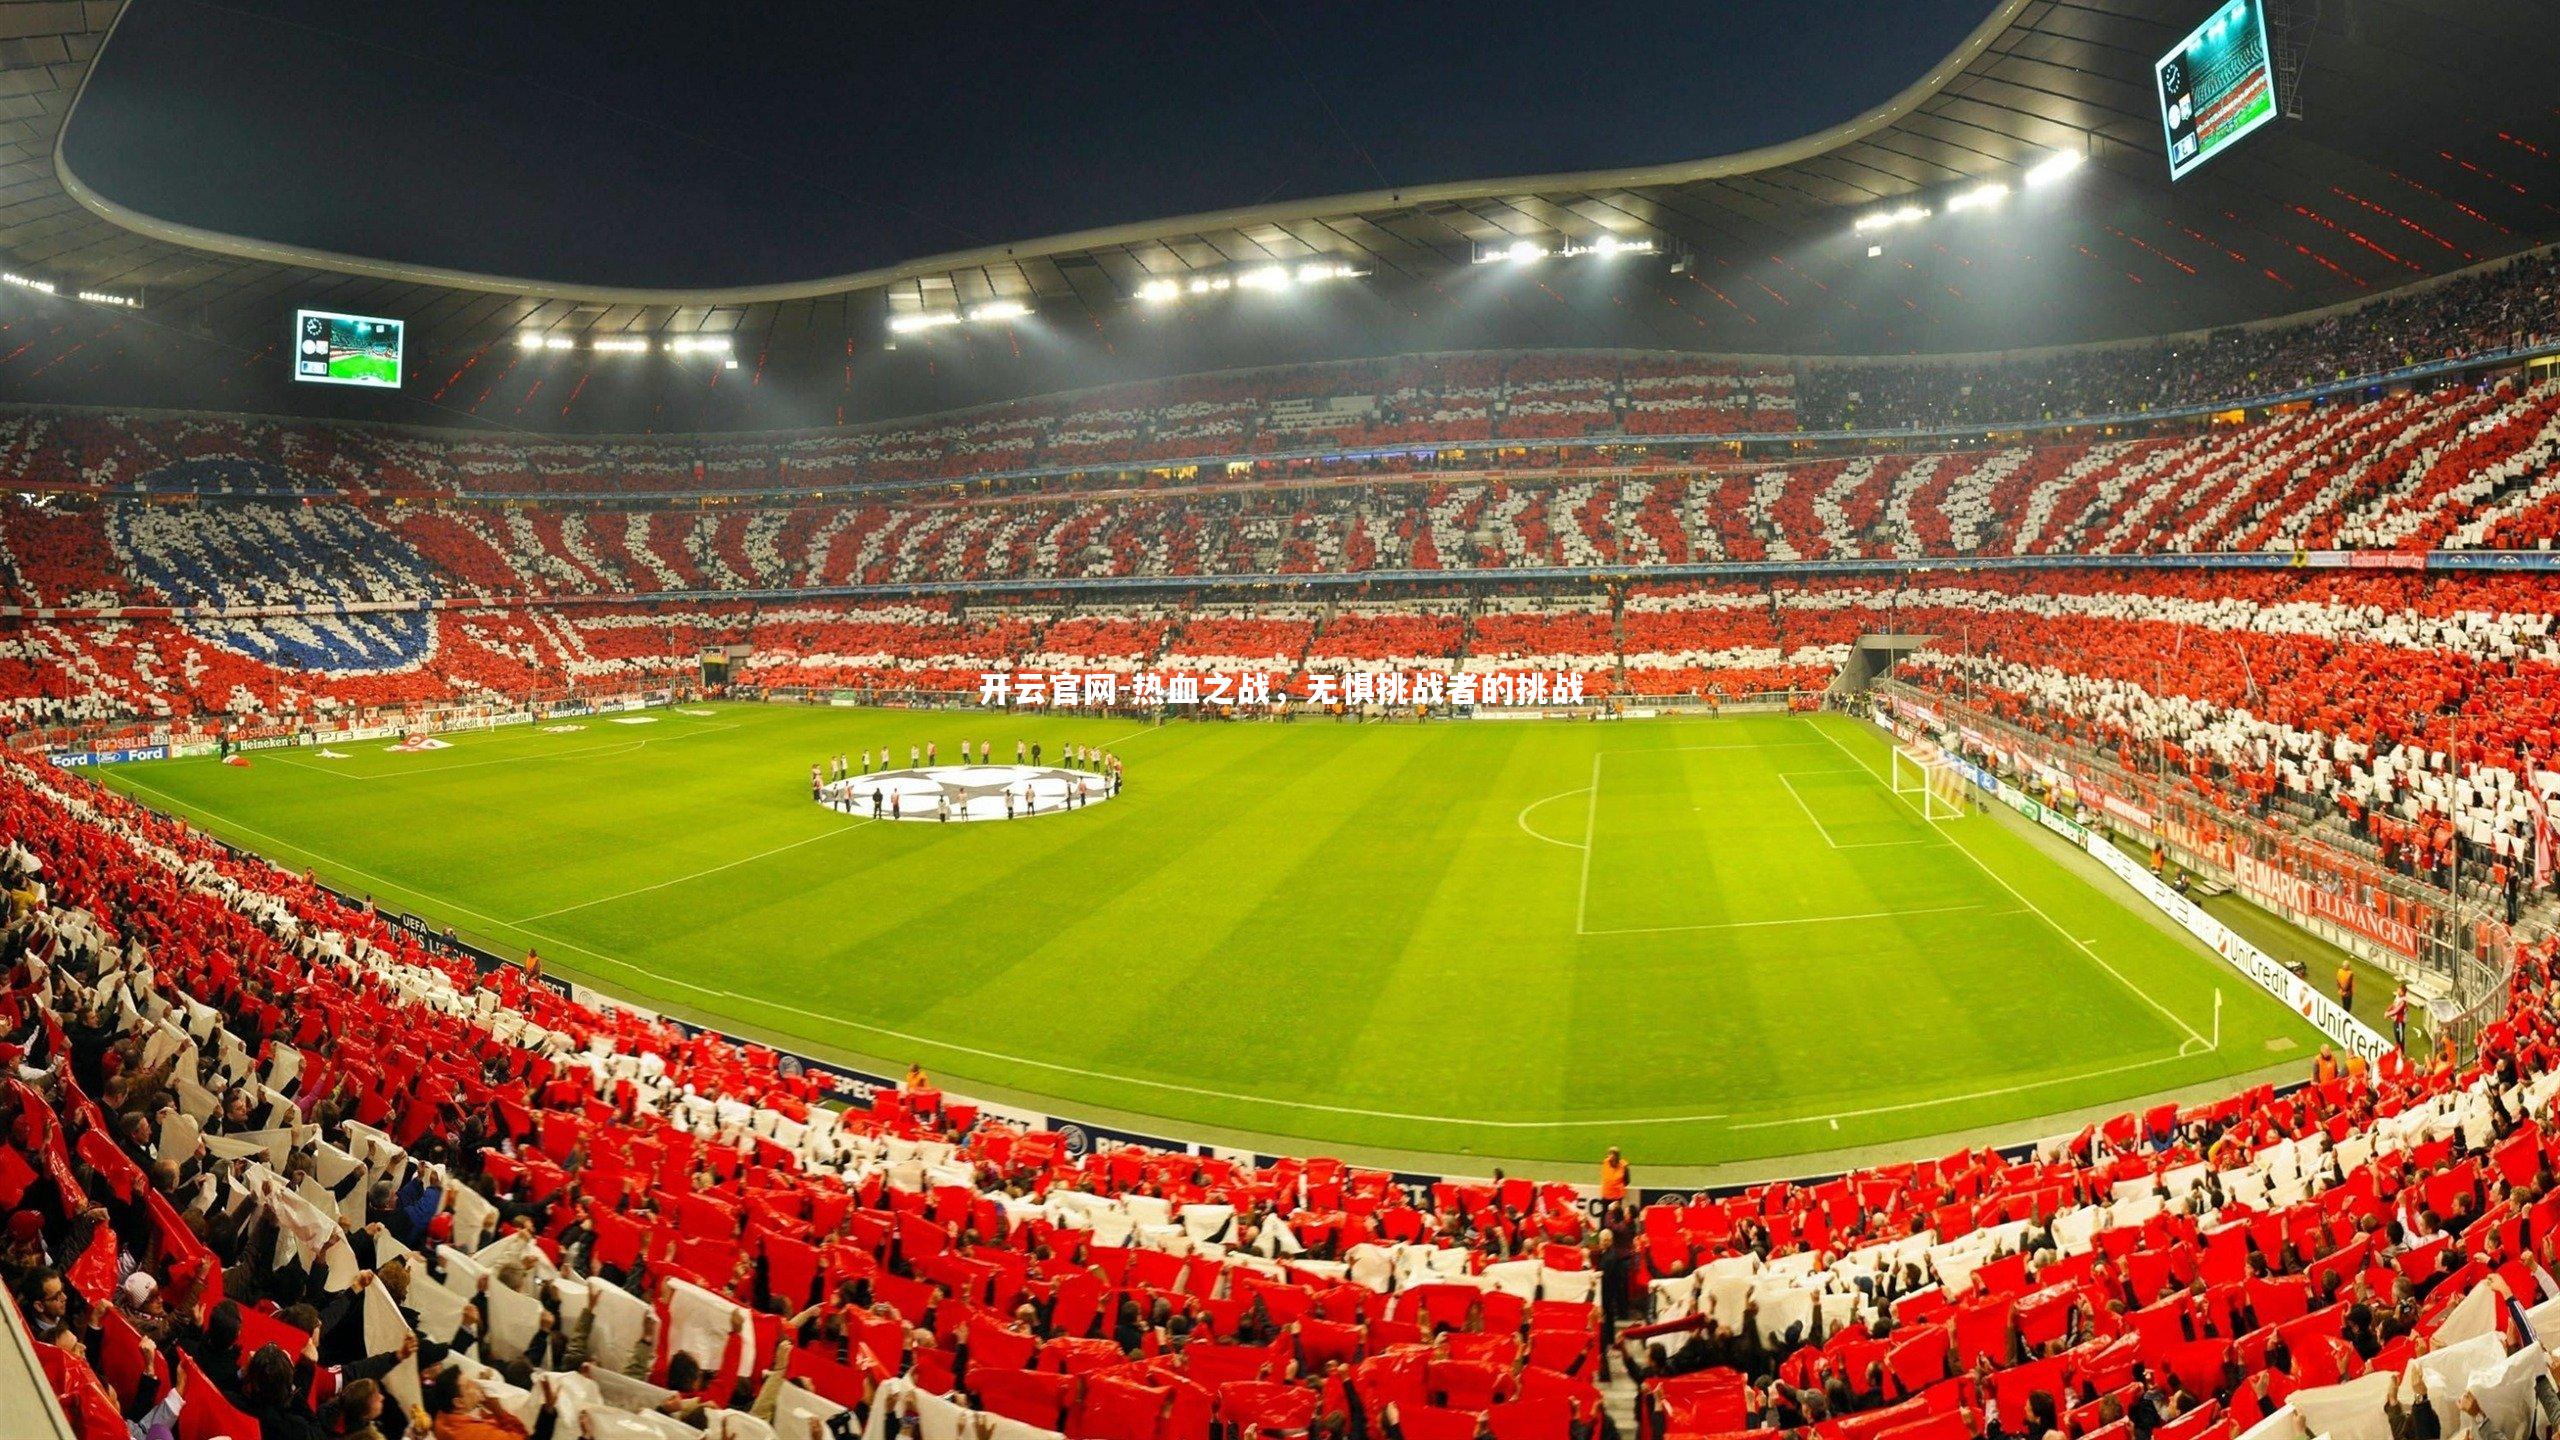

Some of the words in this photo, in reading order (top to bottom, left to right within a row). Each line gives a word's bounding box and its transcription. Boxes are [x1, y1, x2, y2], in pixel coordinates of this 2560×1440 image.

[128, 748, 163, 761] Ford
[240, 739, 289, 751] Heineken
[52, 754, 88, 767] Ford
[2233, 851, 2312, 916] NEUMARKT
[402, 915, 427, 935] UEFA
[2315, 888, 2416, 953] ELLWANGEN
[2230, 937, 2290, 1001] UniCredit
